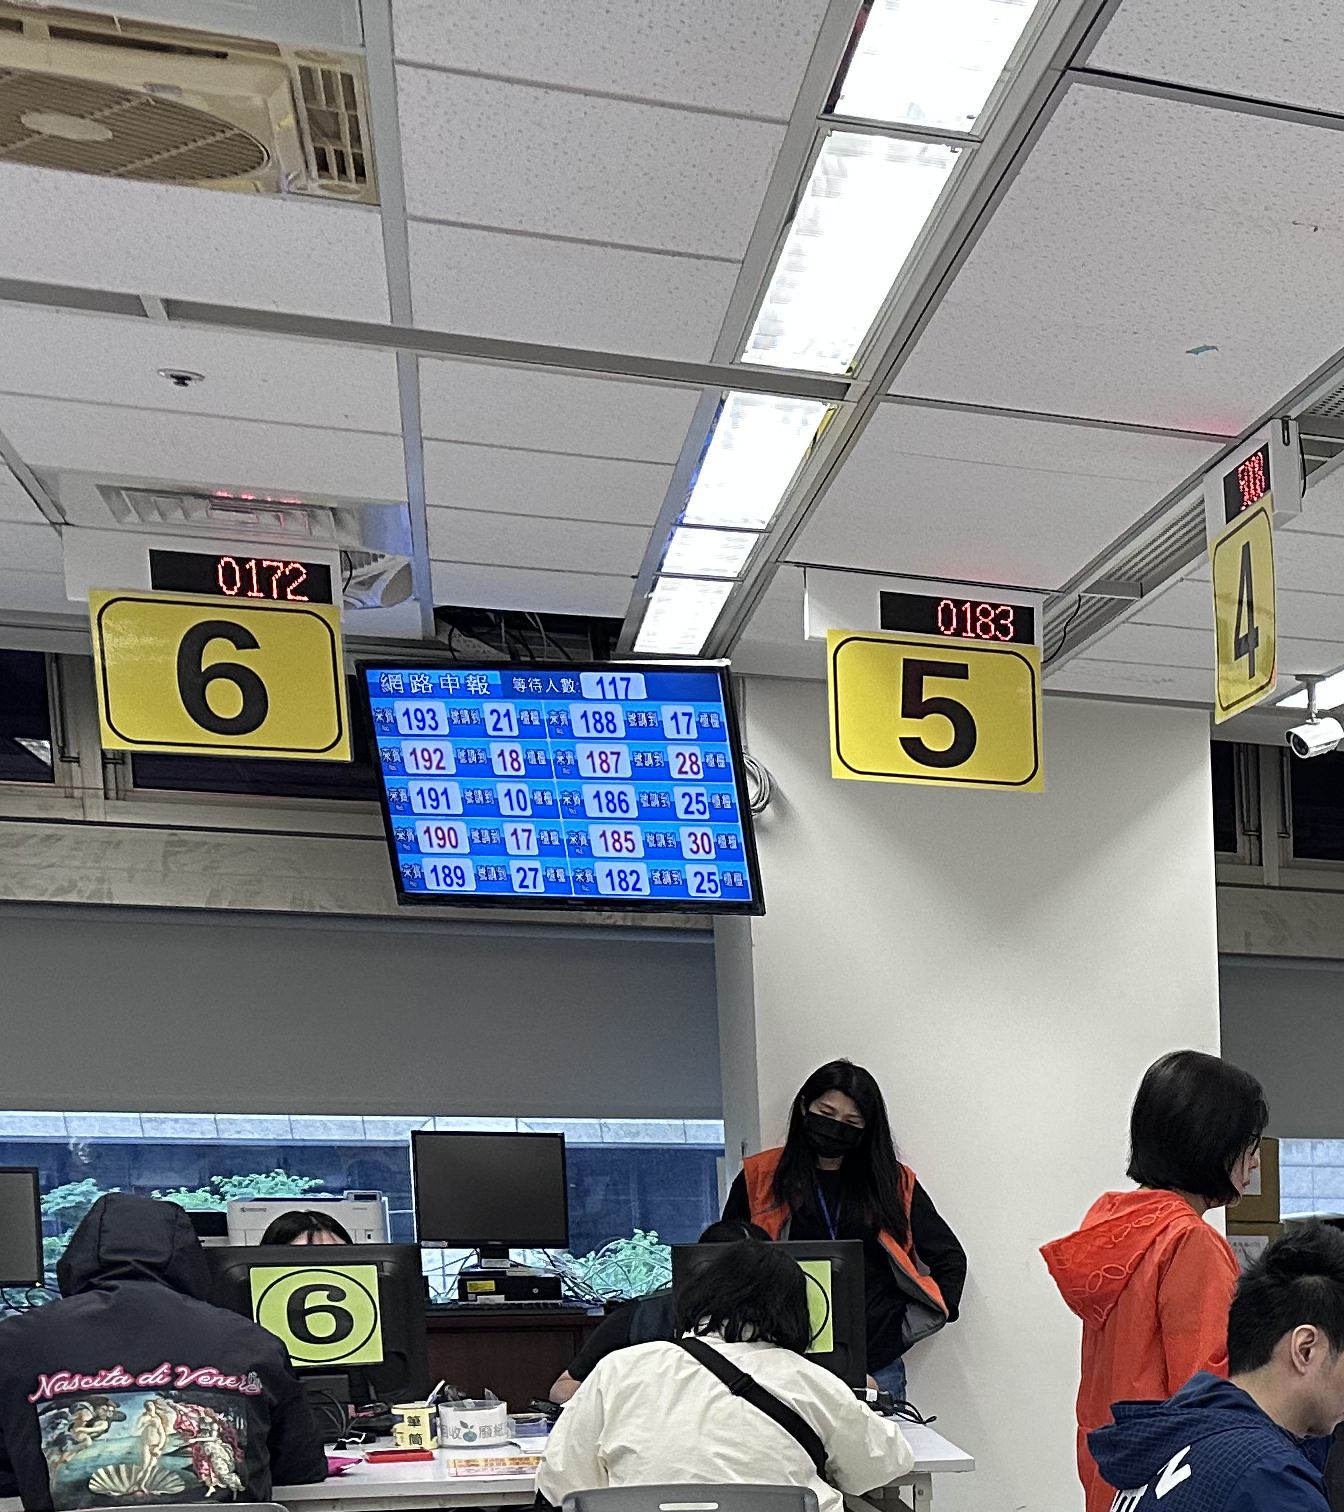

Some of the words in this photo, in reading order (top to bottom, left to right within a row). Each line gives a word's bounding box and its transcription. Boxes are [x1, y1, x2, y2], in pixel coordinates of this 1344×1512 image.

[217, 556, 310, 601] 0172
[937, 600, 1014, 641] 0183
[1234, 541, 1259, 680] 4
[176, 620, 269, 736] 6
[380, 672, 491, 695] 網路申報
[596, 676, 631, 700] 117
[402, 708, 439, 731] 193
[490, 709, 513, 732] 21
[581, 710, 617, 734] 188
[670, 712, 693, 734] 17
[898, 657, 978, 769] 5
[410, 747, 446, 770] 192
[498, 749, 521, 772] 18
[587, 751, 621, 774] 187
[676, 752, 700, 775] 28
[417, 786, 451, 810] 191
[504, 788, 527, 811] 10
[593, 790, 630, 814] 186
[682, 792, 707, 815] 25
[423, 826, 458, 849] 190
[511, 828, 532, 850] 17
[600, 830, 635, 853] 185
[688, 832, 712, 855] 30
[430, 865, 465, 887] 189
[516, 867, 538, 889] 27
[606, 869, 643, 892] 182
[693, 871, 719, 894] 25
[285, 1285, 355, 1345] 6
[29, 1365, 133, 1402] Nascita
[137, 1362, 172, 1387] di
